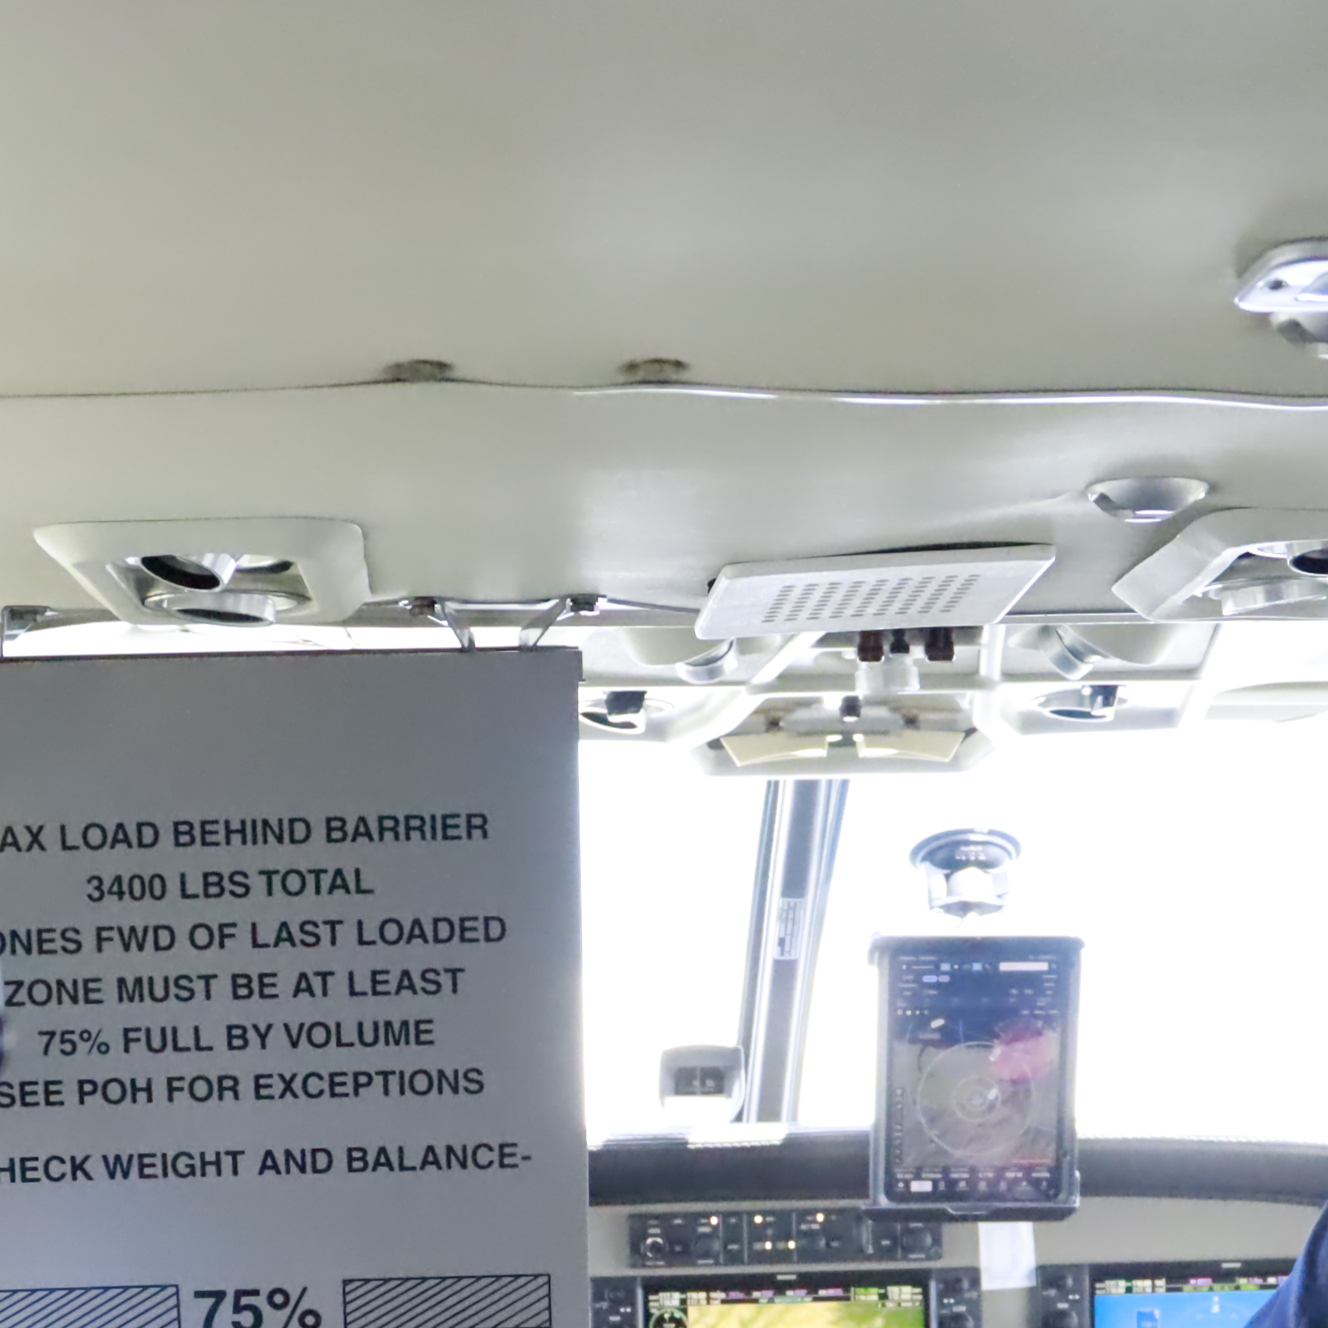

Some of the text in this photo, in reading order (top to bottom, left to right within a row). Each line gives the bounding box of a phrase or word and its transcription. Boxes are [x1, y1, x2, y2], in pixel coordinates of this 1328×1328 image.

[60, 822, 159, 851] LOAD
[173, 818, 311, 847] BEHIND
[326, 813, 488, 843] BARRIER
[87, 868, 374, 902] 3400 LBS TOTAL
[96, 925, 175, 953] FWD
[189, 922, 237, 950] OF
[251, 920, 343, 948] LAST
[357, 916, 506, 946] LOADED
[4, 968, 465, 1007] ZONE MUST BE AT LEAST
[38, 1019, 434, 1056] 75% FULL BY VOLUME
[78, 1078, 153, 1105] POH
[167, 1075, 239, 1102] FOR
[254, 1068, 484, 1100] EXCEPTIONS
[102, 1151, 245, 1180] WEIGHT
[258, 1148, 333, 1175] AND
[347, 1143, 531, 1172] BALANCE-
